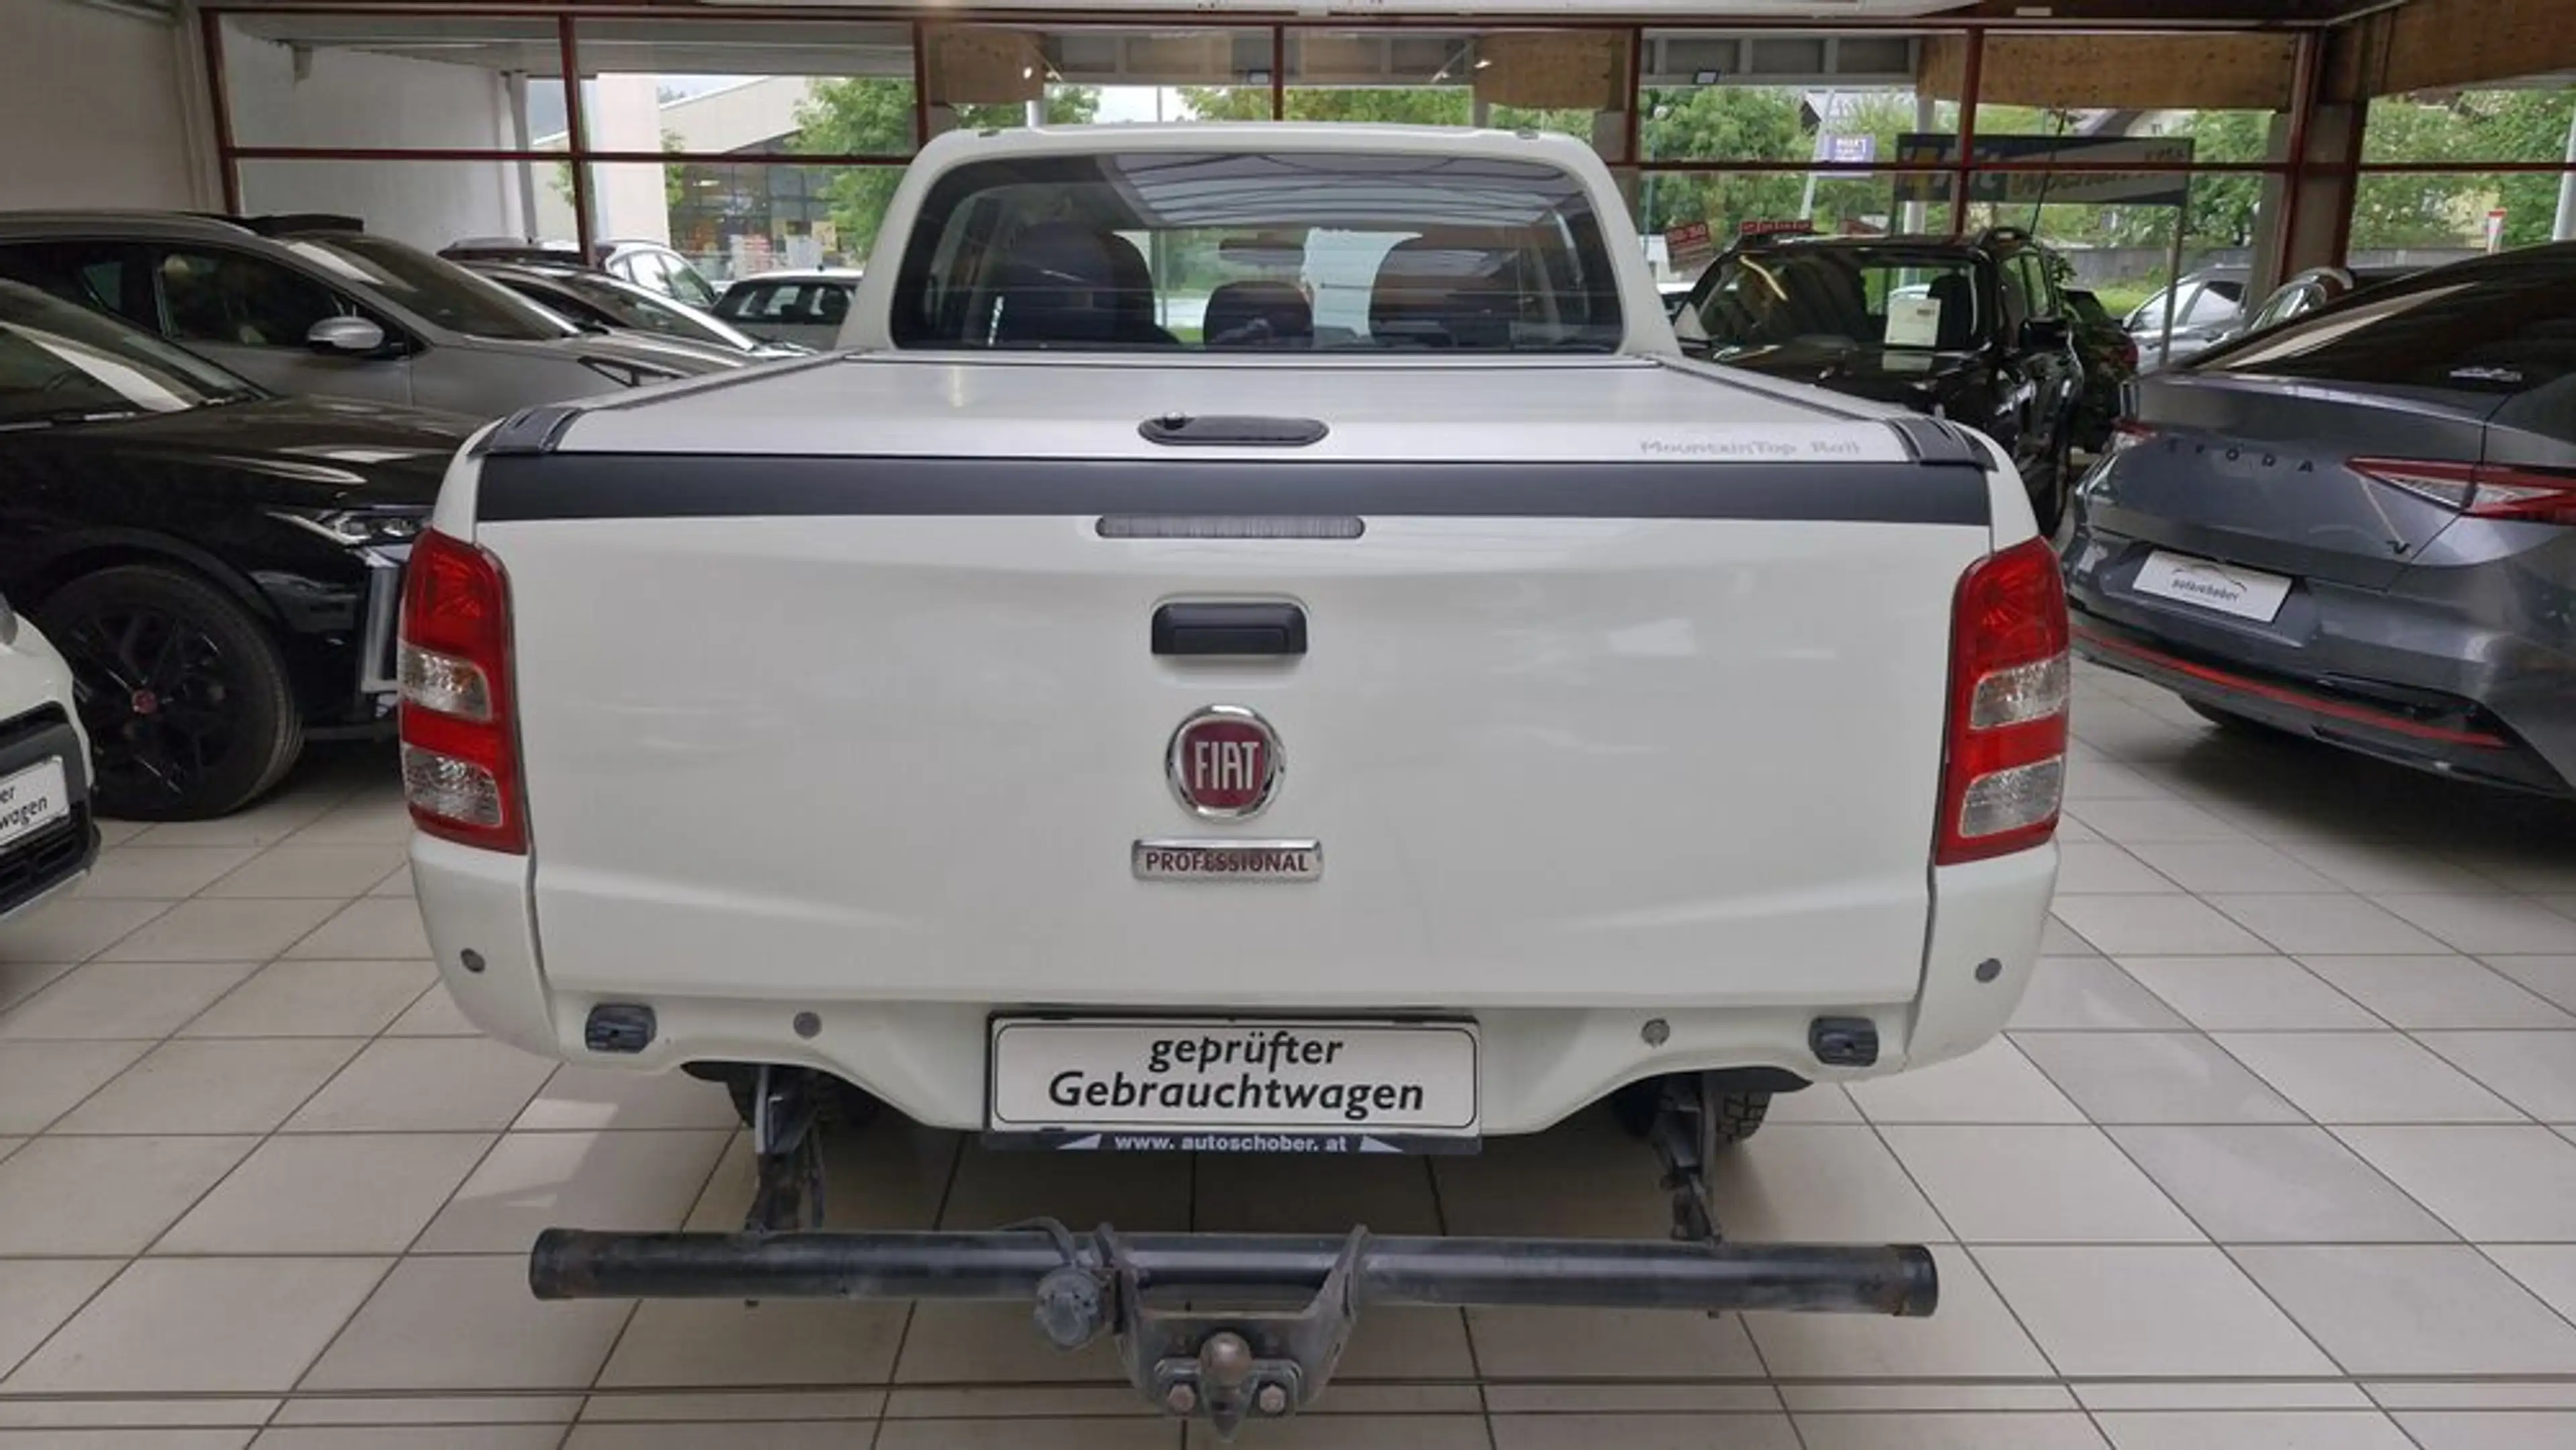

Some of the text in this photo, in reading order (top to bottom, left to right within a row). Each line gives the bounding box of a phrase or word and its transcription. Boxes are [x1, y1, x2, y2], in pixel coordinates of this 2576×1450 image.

[1194, 741, 1260, 790] FIAT
[1146, 851, 1309, 872] PROFESSIONAL
[1148, 1031, 1344, 1072] geprüfter
[1048, 1072, 1424, 1120] Gebrauchtwagen
